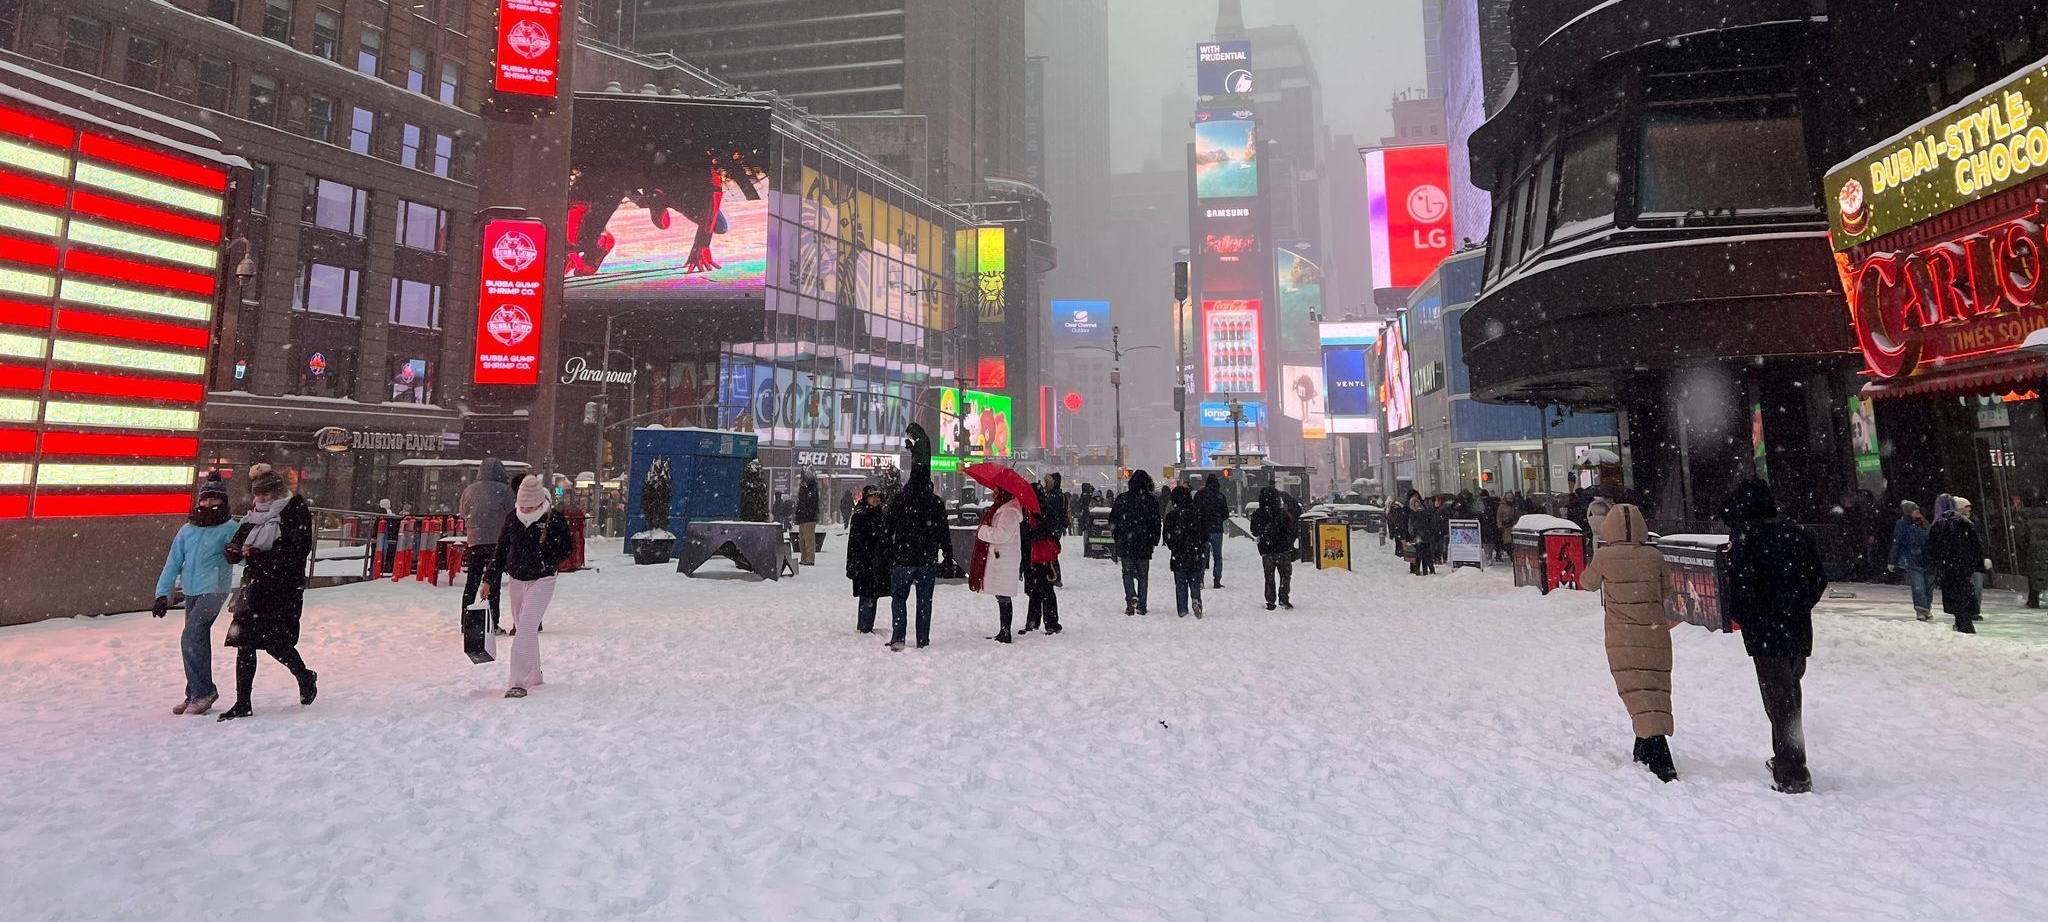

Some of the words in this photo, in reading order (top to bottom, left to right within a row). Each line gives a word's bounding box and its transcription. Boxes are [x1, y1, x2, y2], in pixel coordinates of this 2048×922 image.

[507, 3, 539, 11] SHRIMP
[1200, 45, 1220, 54] WITH
[1200, 52, 1247, 62] PRUDENTIAL
[501, 64, 528, 72] BUBBA
[529, 67, 553, 76] GUMP
[503, 71, 534, 80] SHRIMP
[1869, 91, 2028, 194] DUBAI-STYLE
[1955, 122, 2048, 195] CHOCO
[1206, 208, 1250, 217] SAMSUNG
[1413, 228, 1447, 249] LG
[485, 279, 514, 288] BUBBA
[515, 281, 540, 289] GUMP
[488, 287, 520, 295] SHRIMP
[521, 288, 536, 296] CO.
[1947, 325, 1995, 351] TIMES
[480, 354, 509, 362] BUBBA
[510, 355, 535, 363] GUMP
[482, 361, 515, 370] SHRIMP
[516, 362, 531, 370] CO.
[561, 356, 637, 385] Paramount
[352, 431, 403, 450] RAISING
[405, 434, 445, 451] CANE'S
[797, 451, 851, 466] SKECRS
